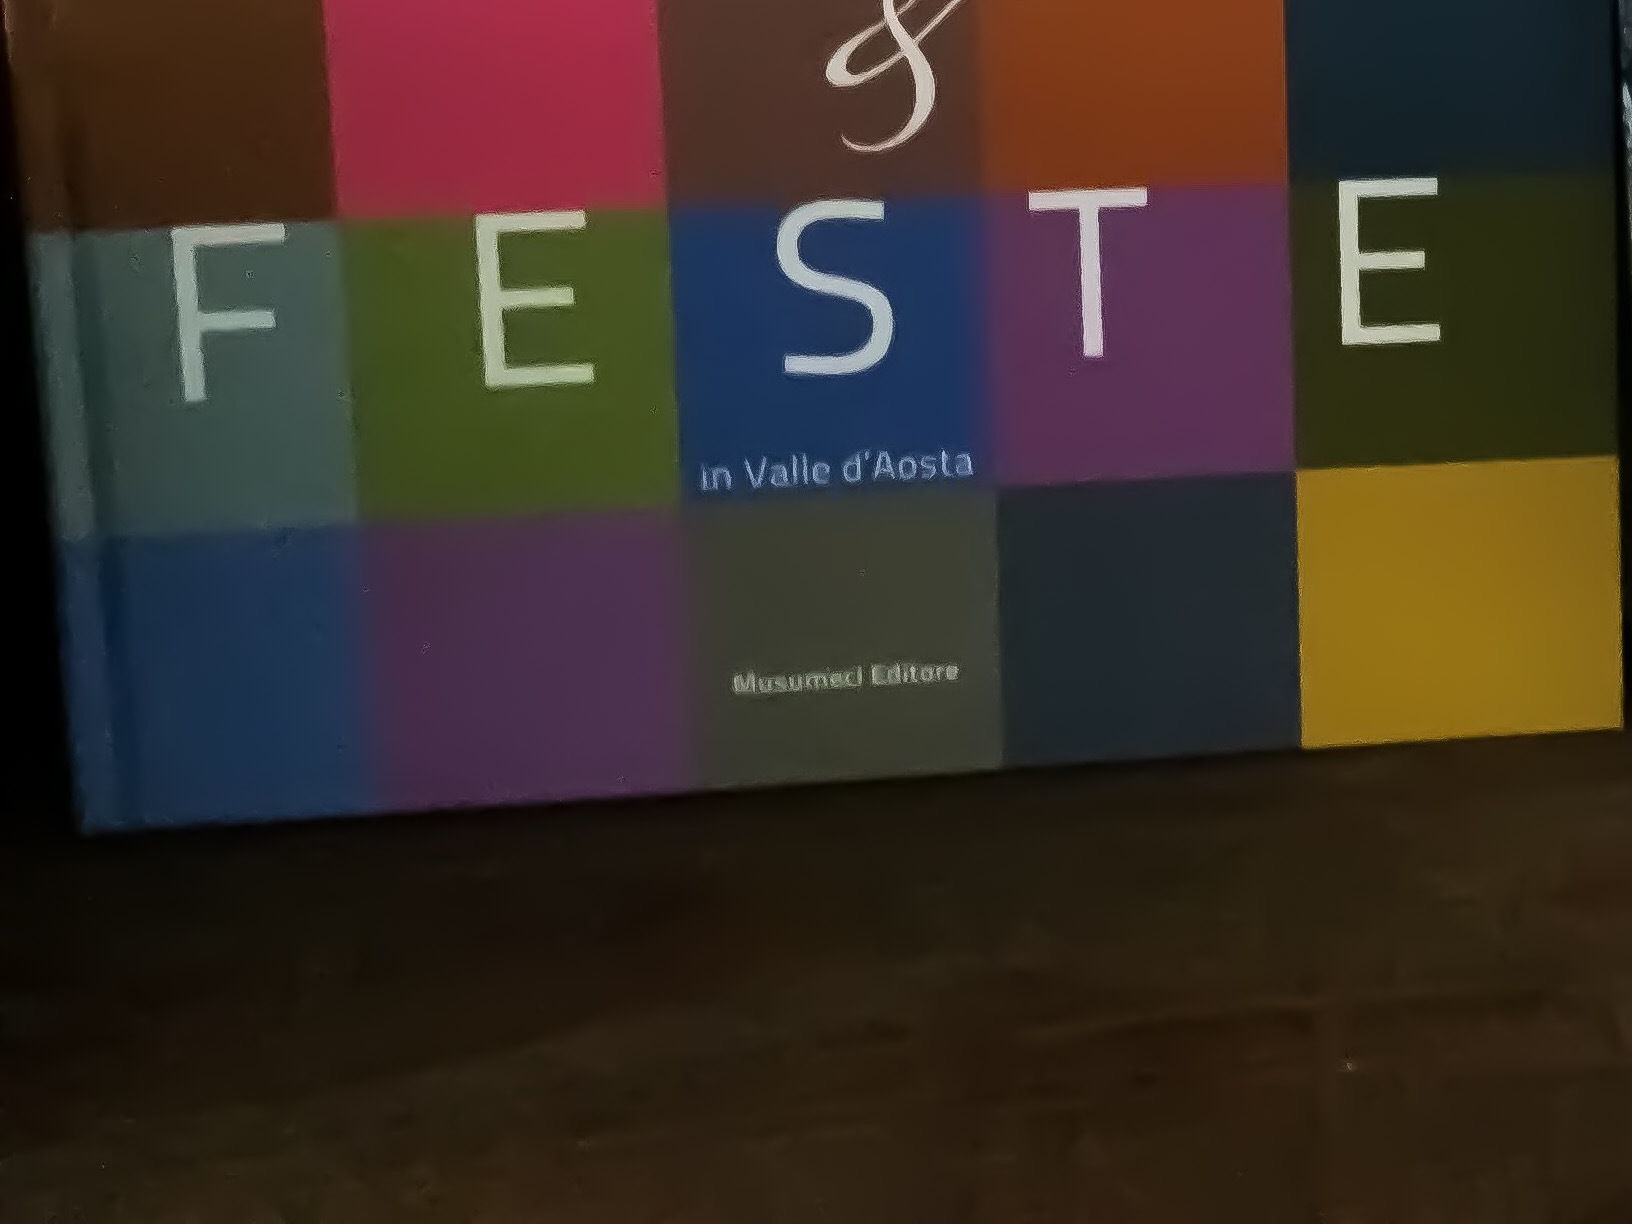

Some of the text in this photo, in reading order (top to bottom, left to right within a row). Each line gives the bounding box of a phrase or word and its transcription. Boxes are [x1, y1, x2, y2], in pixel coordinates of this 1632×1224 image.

[170, 176, 1442, 404] FESTE
[700, 447, 976, 491] in Valle d'Aosta
[730, 658, 961, 694] Musumeci Editore
